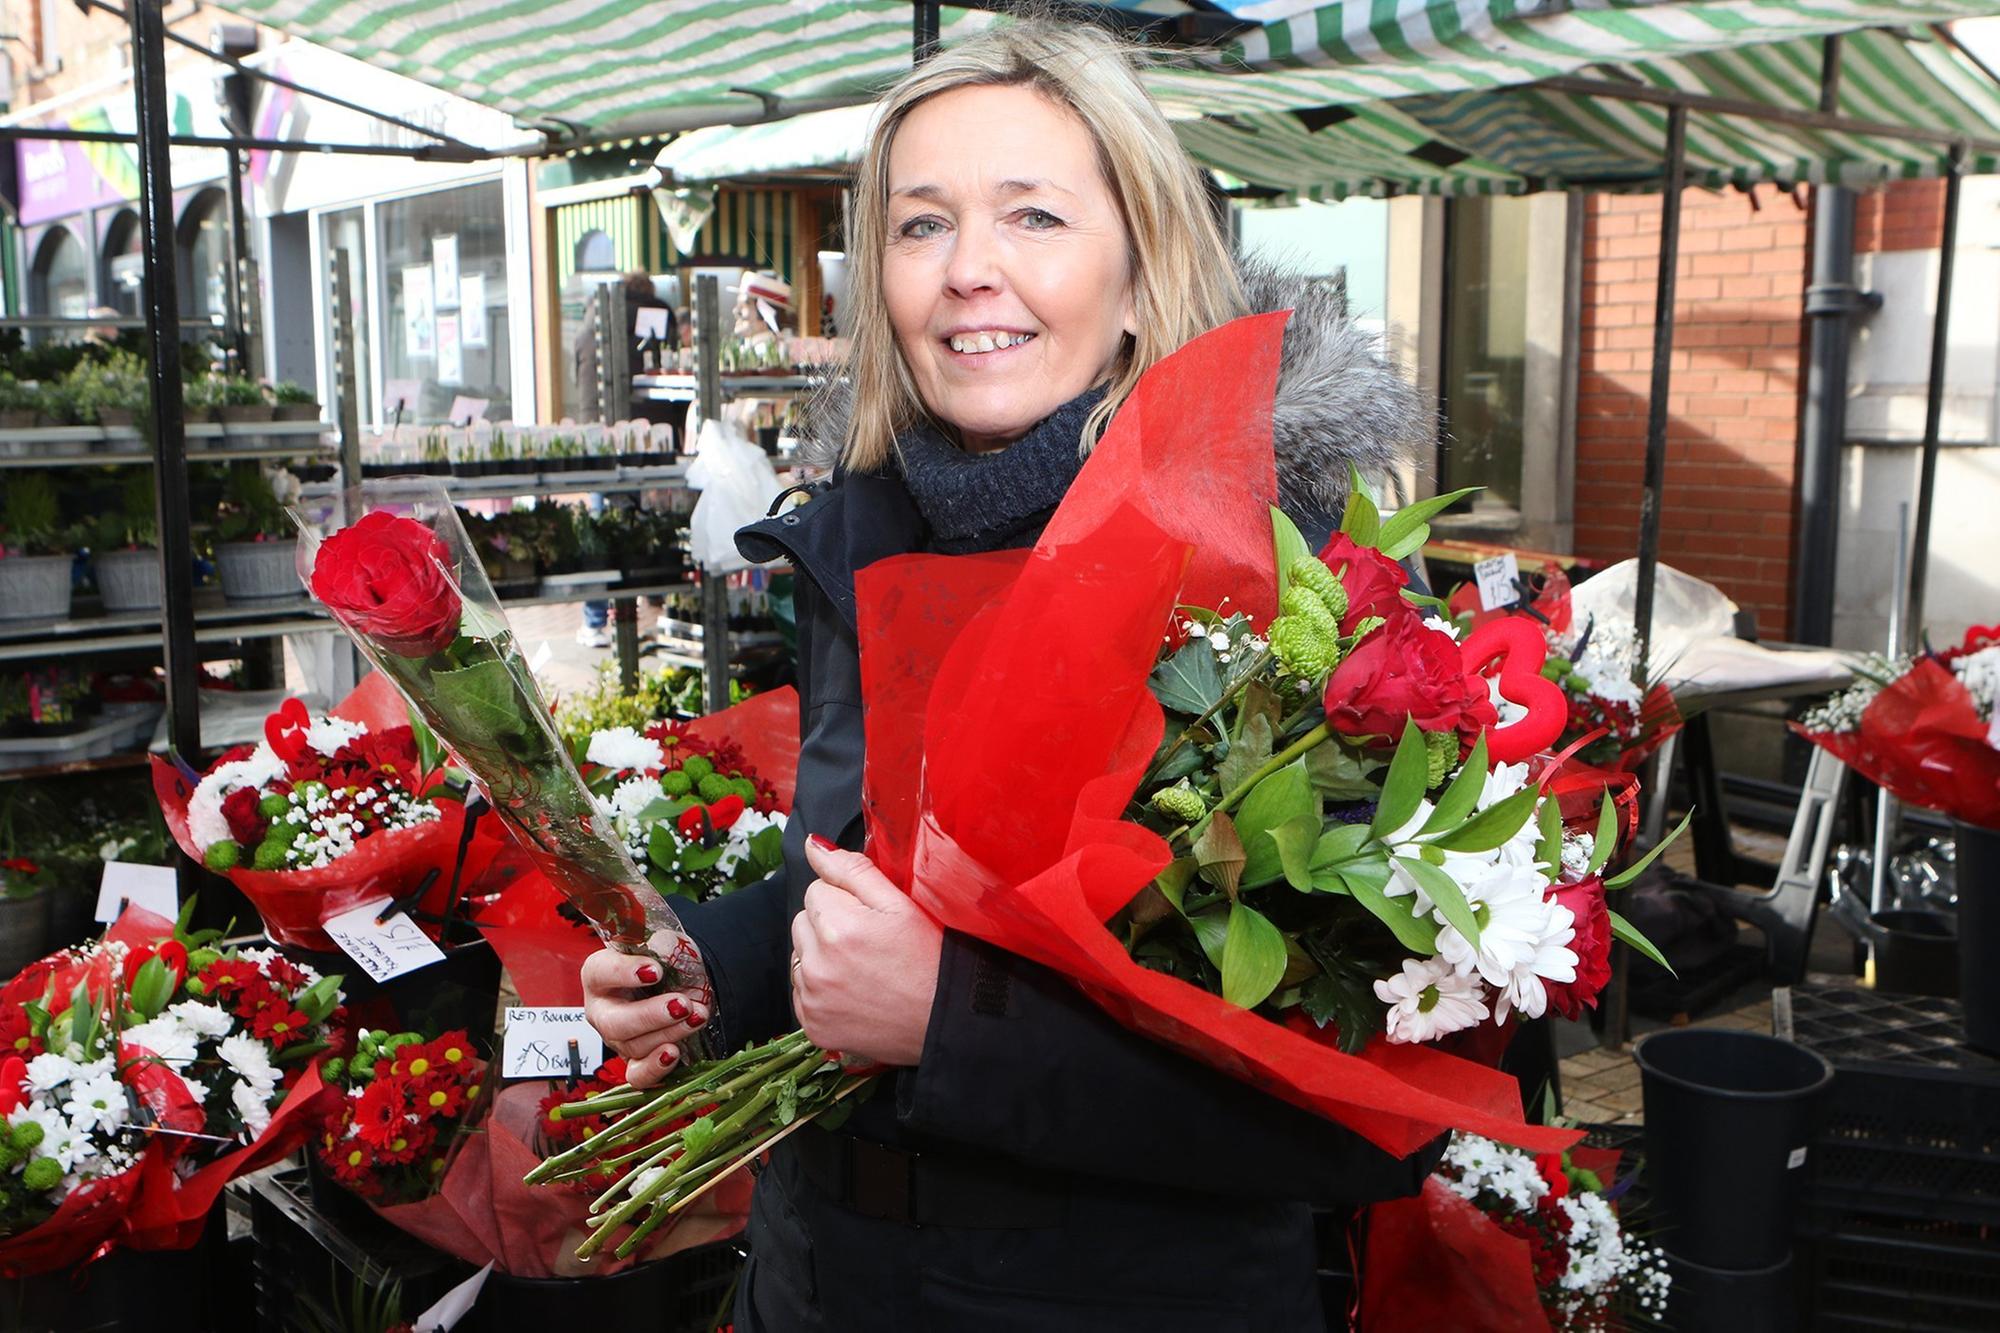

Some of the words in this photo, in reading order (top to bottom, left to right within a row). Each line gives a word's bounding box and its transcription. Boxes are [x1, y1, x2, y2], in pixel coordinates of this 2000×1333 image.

[509, 1010, 537, 1024] RED
[541, 1010, 585, 1024] BOUQUE
[551, 1055, 589, 1071] BUNH
